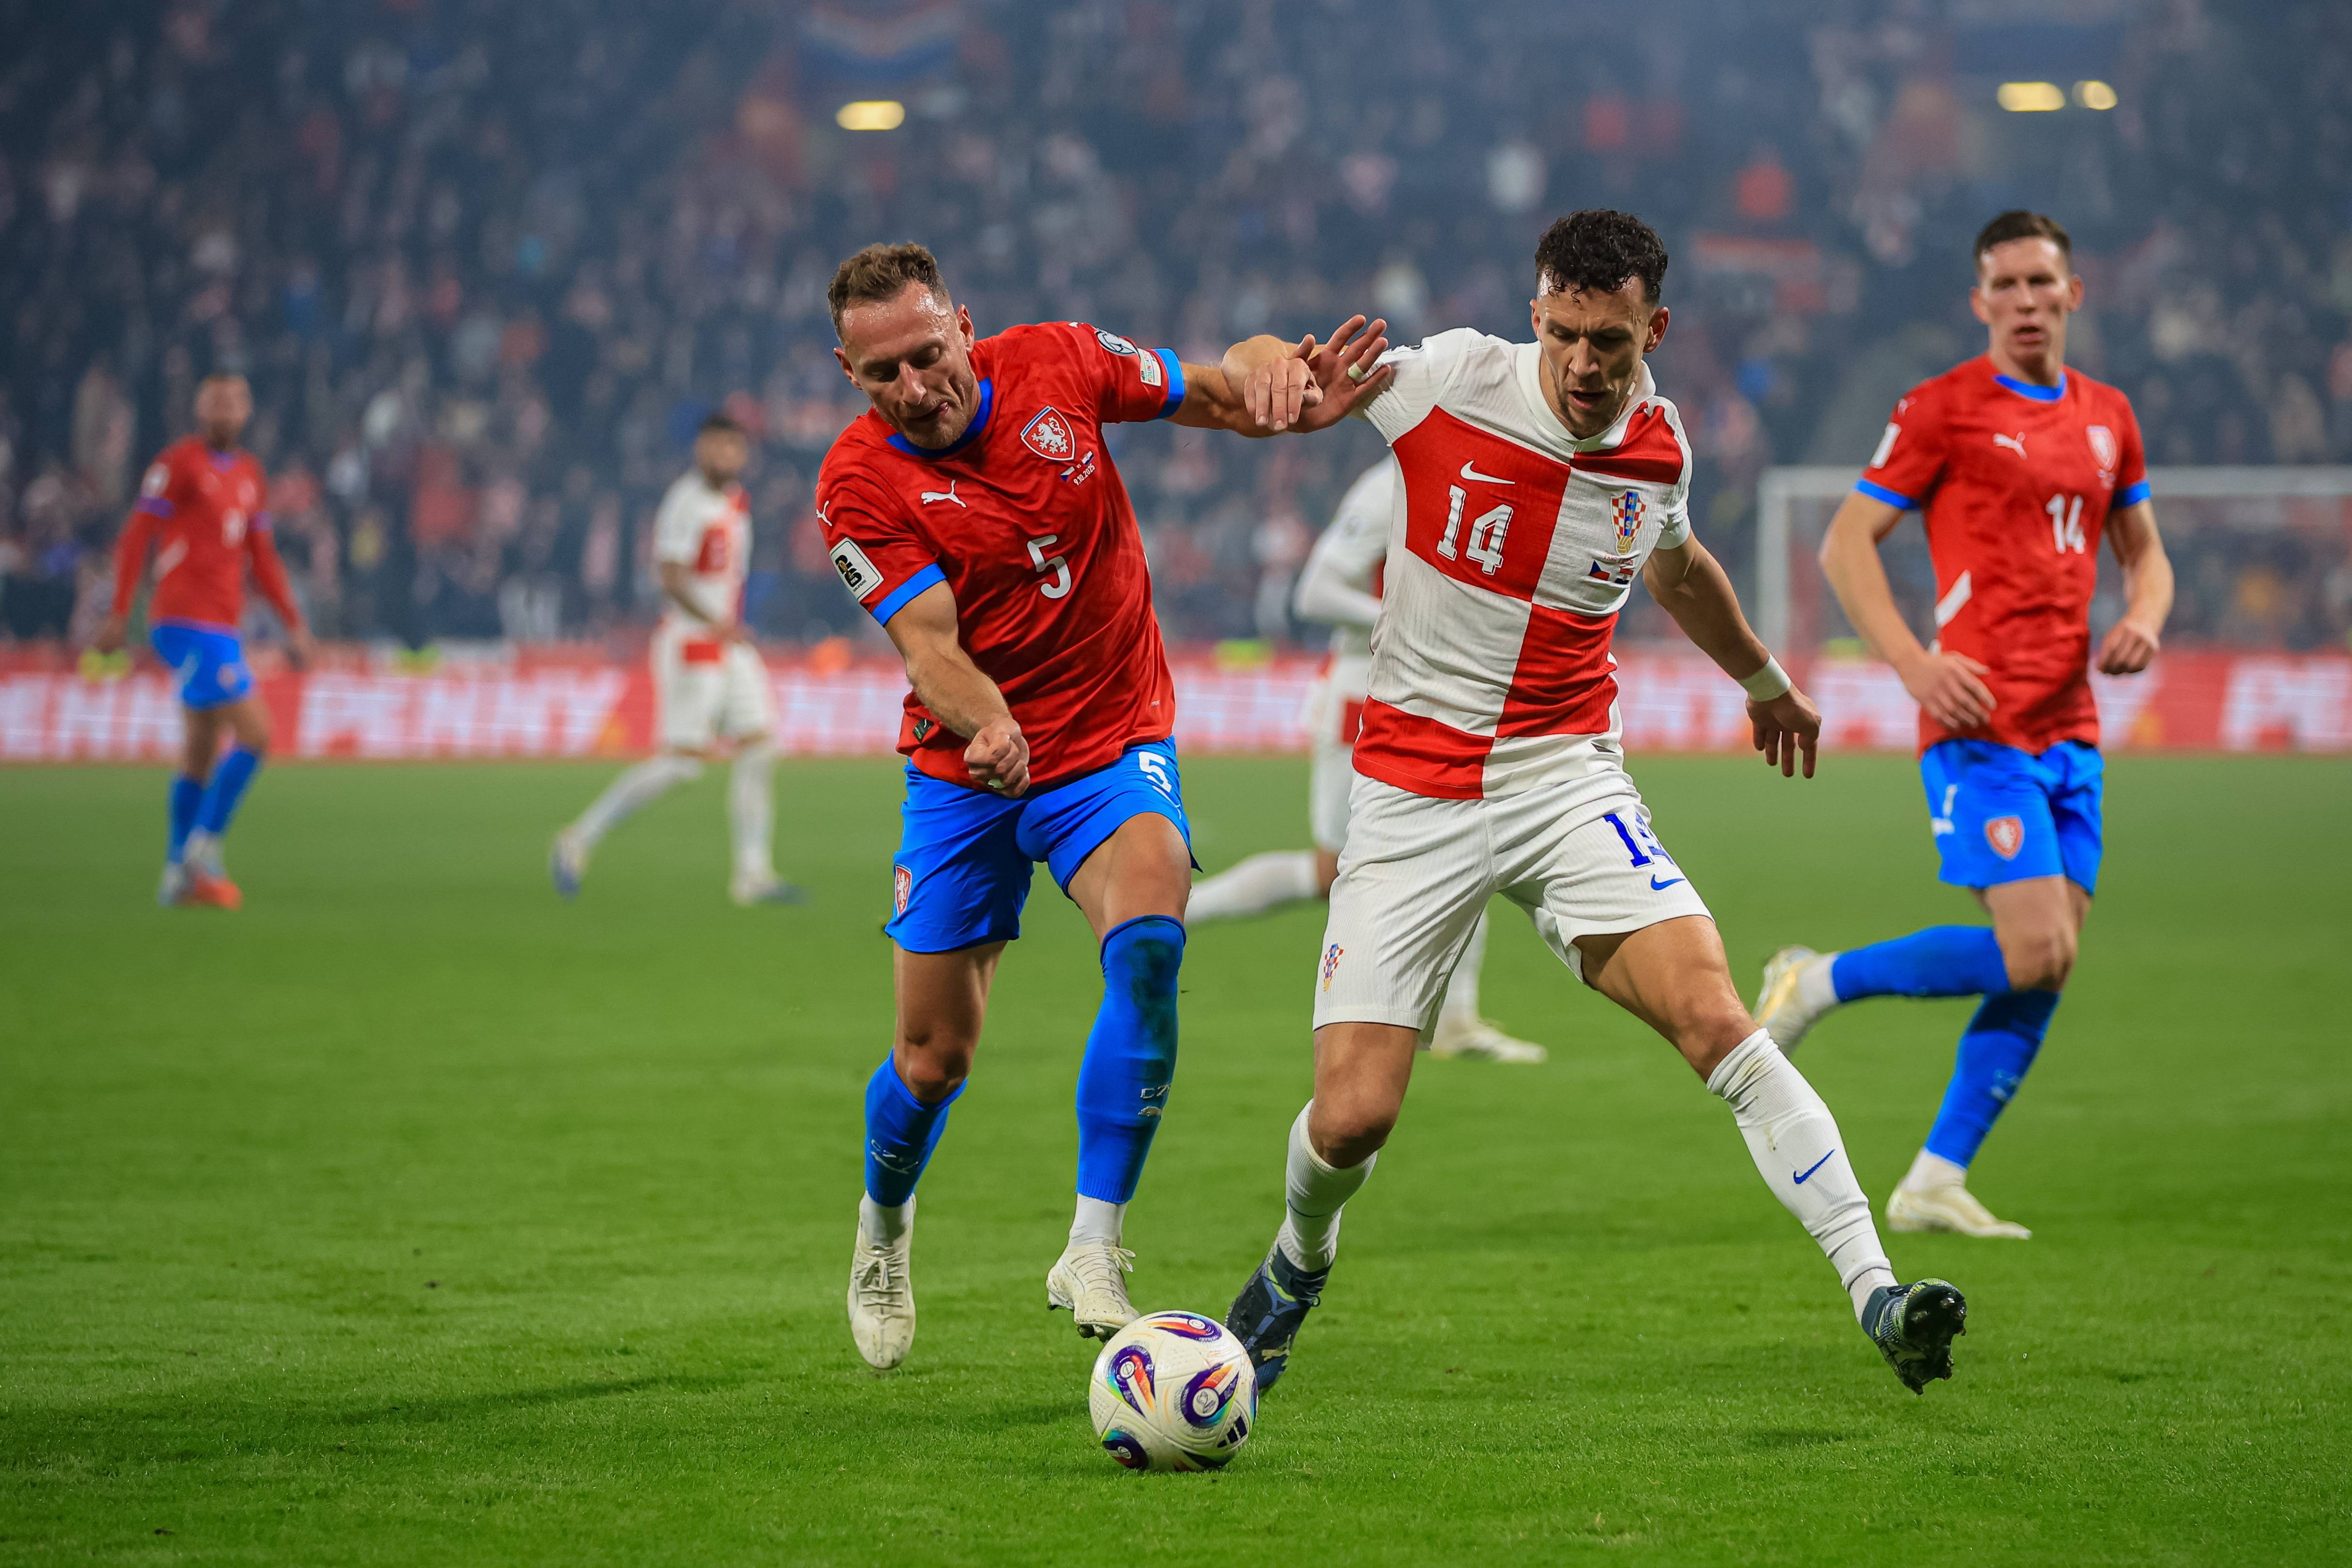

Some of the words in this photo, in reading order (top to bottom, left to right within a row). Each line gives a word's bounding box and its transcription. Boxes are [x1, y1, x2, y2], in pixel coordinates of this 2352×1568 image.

[1073, 463, 1095, 485] 9.10.2025
[1437, 484, 1514, 576] 14
[1625, 496, 1635, 530] HNS
[2045, 493, 2086, 554] 14
[1027, 534, 1071, 598] 5
[1138, 751, 1172, 792] 5
